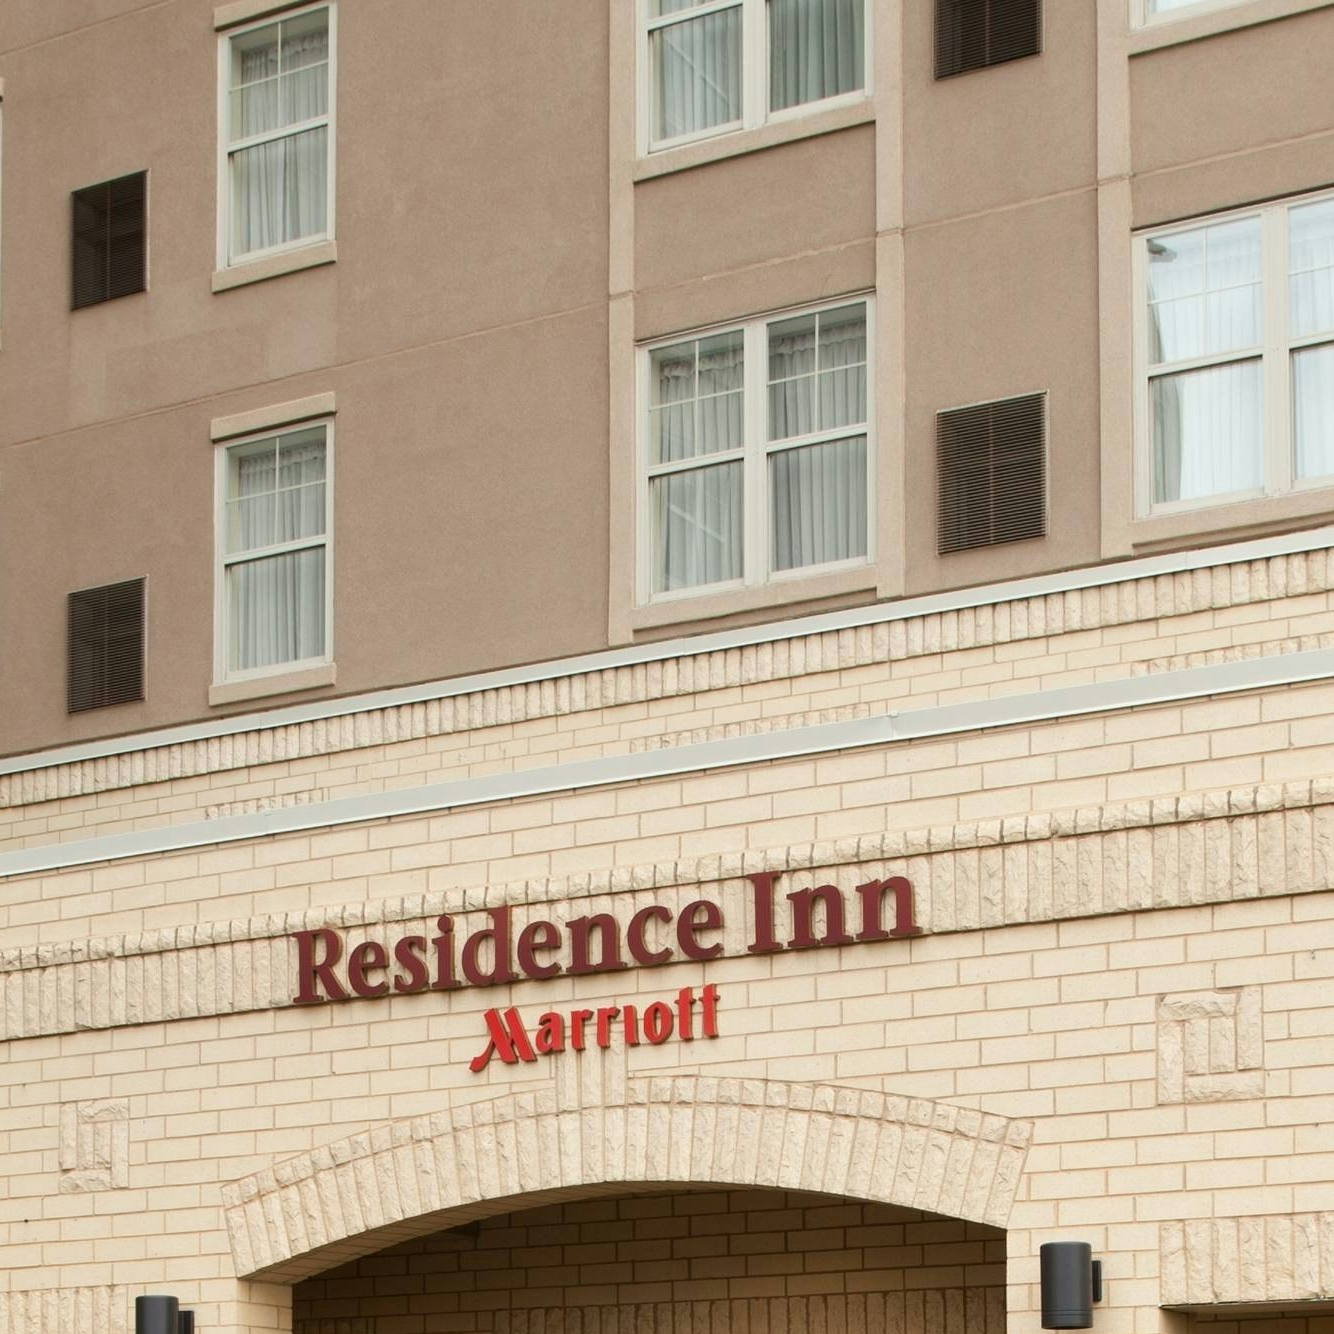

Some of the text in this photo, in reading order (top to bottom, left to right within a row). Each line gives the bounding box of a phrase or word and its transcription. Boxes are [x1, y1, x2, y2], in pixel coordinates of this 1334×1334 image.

[292, 870, 923, 1003] Residence Inn
[469, 983, 722, 1073] Marriott
